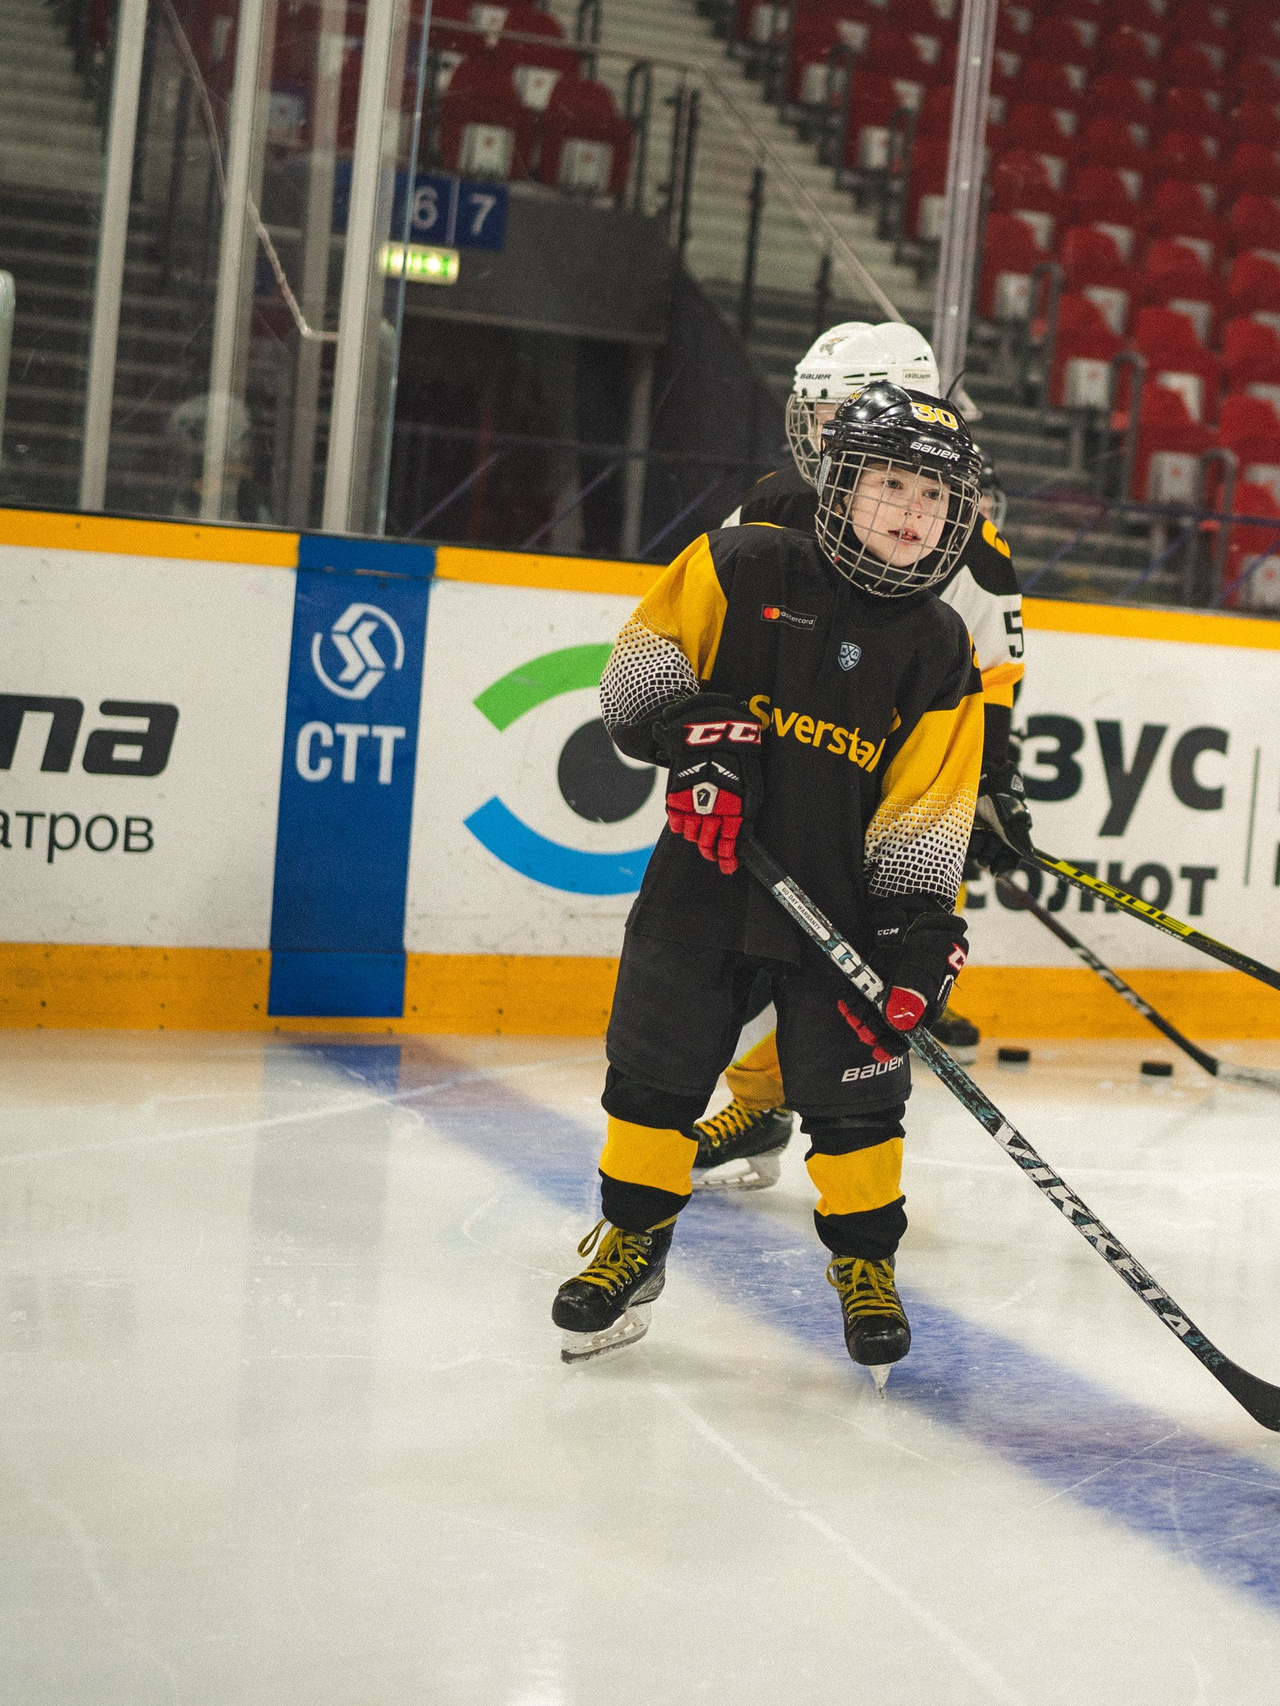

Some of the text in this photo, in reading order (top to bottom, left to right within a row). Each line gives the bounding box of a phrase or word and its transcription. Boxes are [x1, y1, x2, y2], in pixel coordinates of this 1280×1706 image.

[411, 185, 498, 236] 6 7
[799, 372, 832, 381] BAUER
[910, 401, 959, 431] 30
[909, 440, 961, 462] BAUER
[780, 610, 815, 625] astercard
[1003, 609, 1025, 659] 5
[748, 694, 887, 773] Sverstal
[789, 895, 798, 905] DAY
[797, 904, 821, 931] WARRANTY
[877, 927, 899, 936] CCM
[831, 941, 884, 1013] GR
[841, 1055, 904, 1082] BAUER
